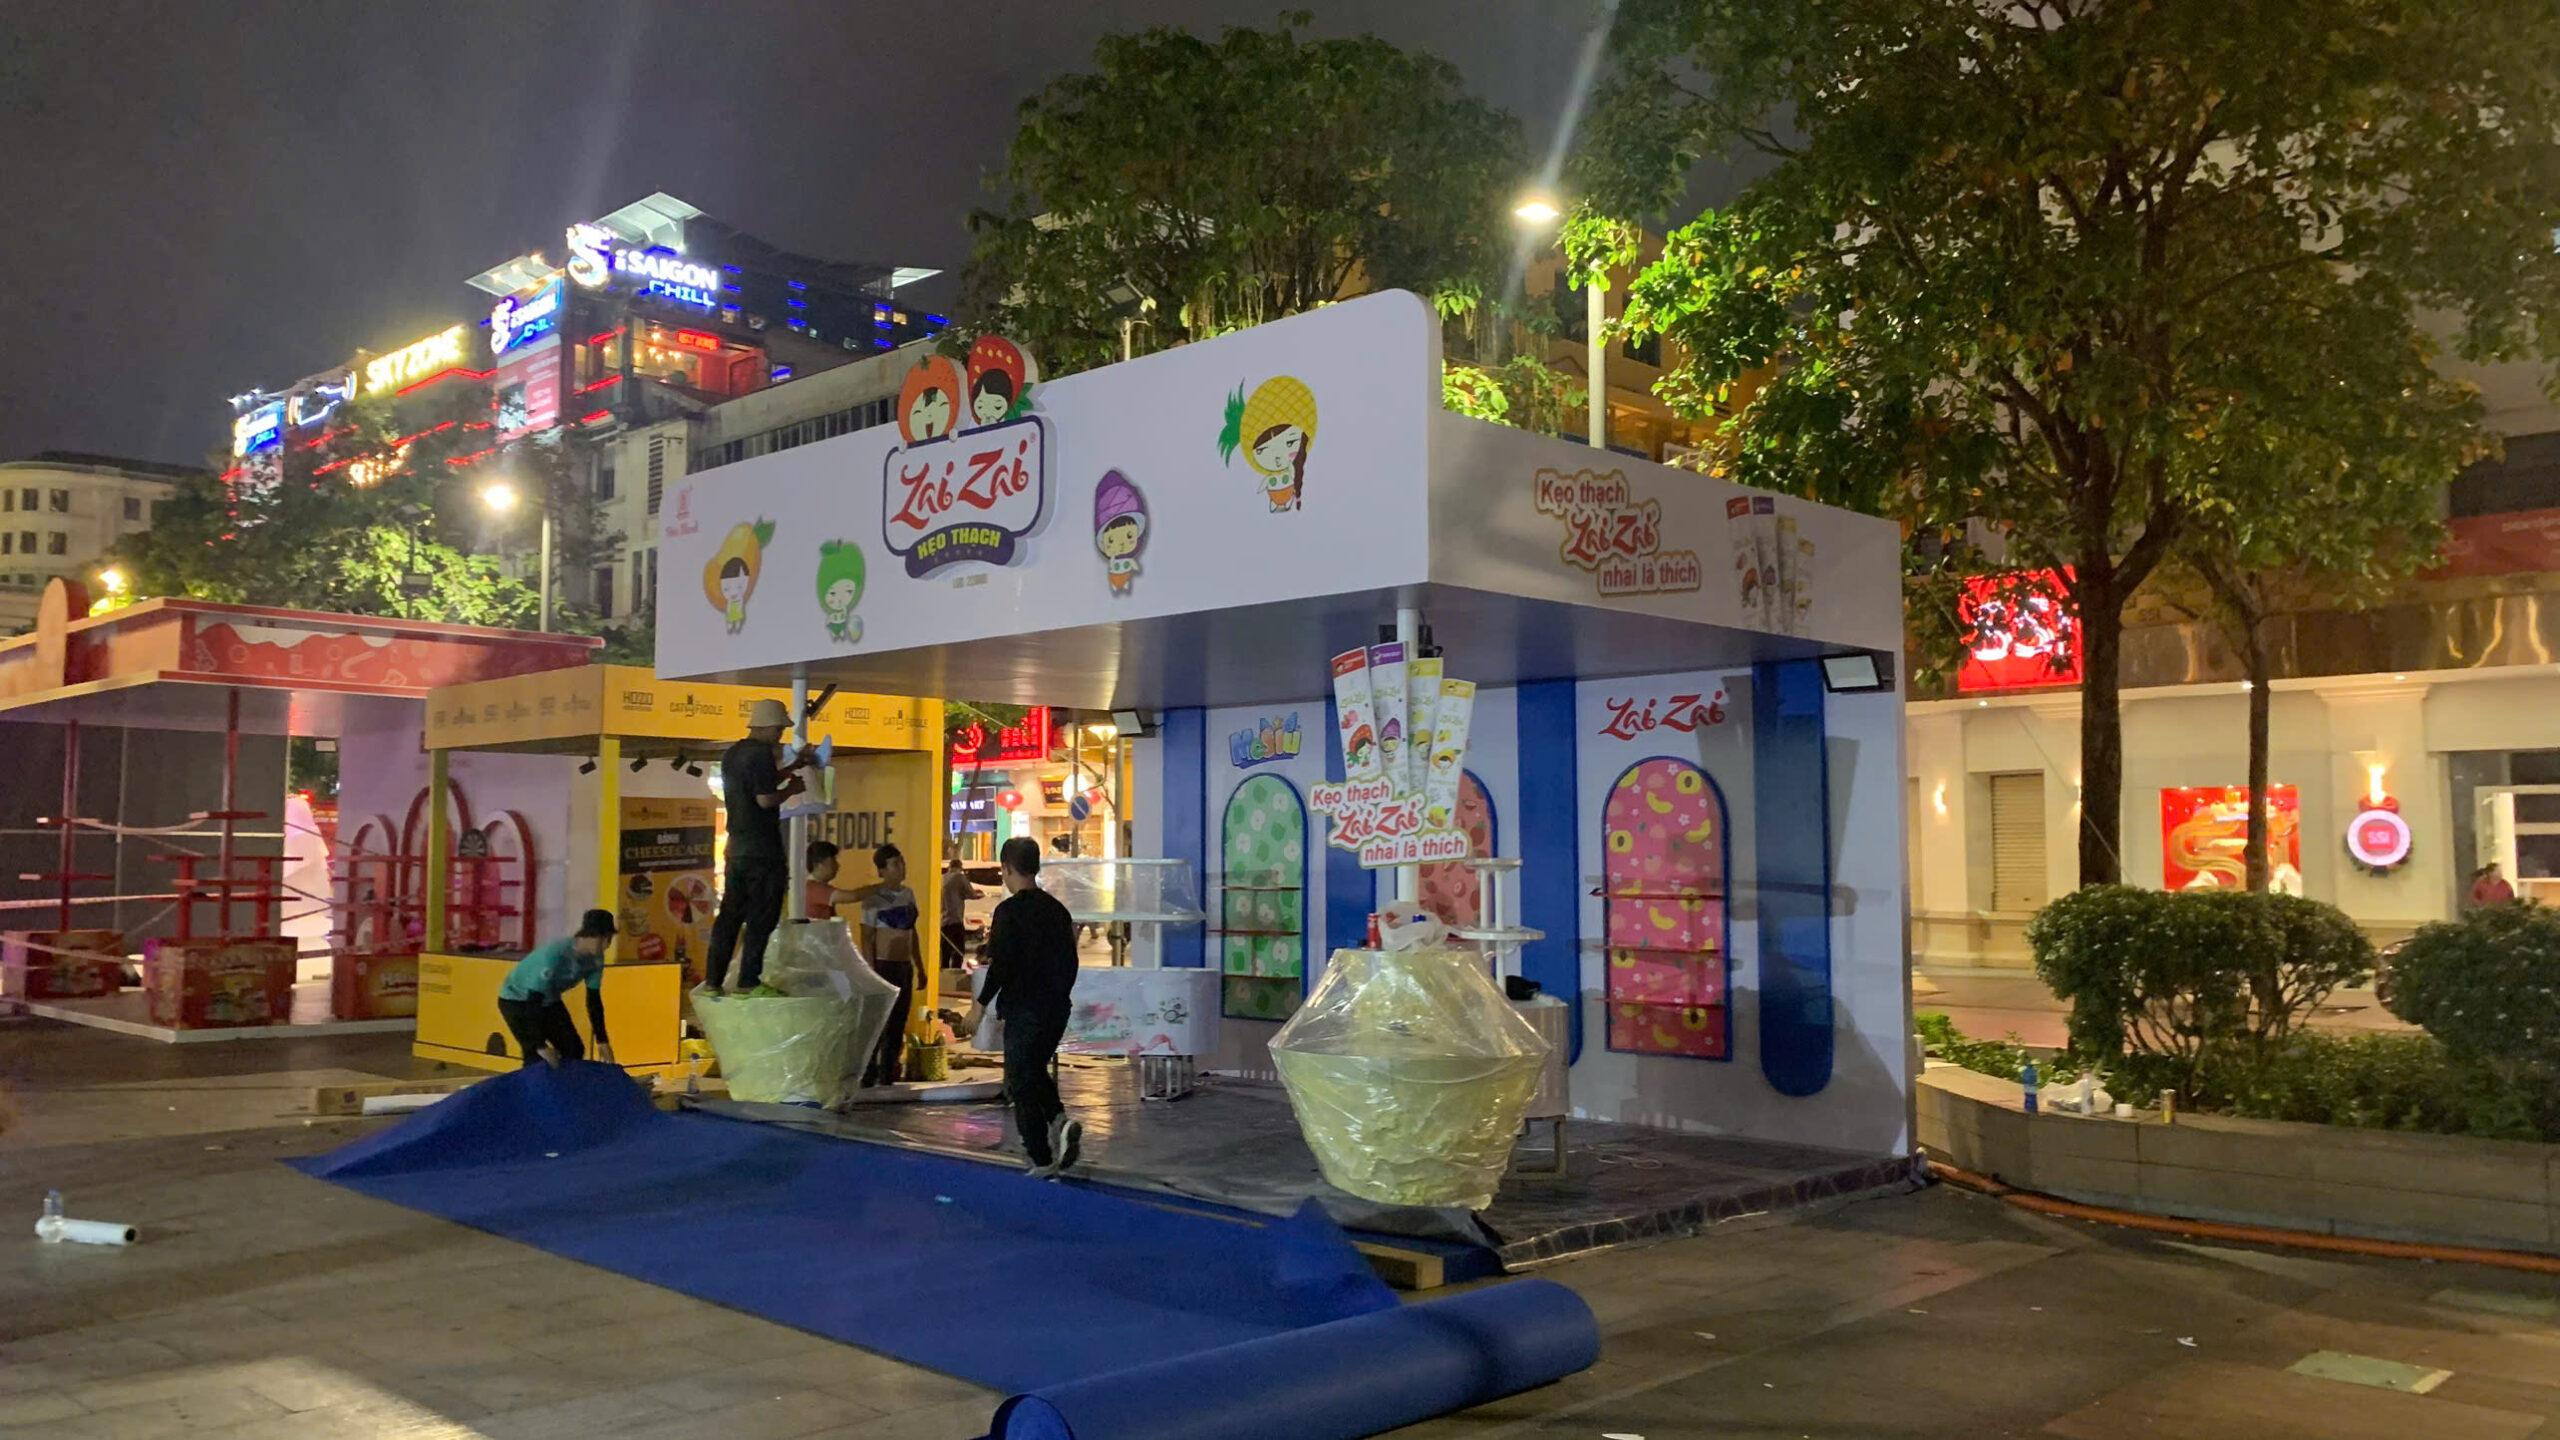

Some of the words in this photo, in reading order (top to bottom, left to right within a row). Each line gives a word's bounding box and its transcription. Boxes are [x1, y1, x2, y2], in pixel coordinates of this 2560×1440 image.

[649, 280, 716, 307] CHILL
[890, 461, 954, 530] Zai
[957, 440, 1029, 510] Zai
[1541, 480, 1574, 509] Kẹo
[1580, 480, 1624, 508] thạch
[951, 527, 1001, 548] THẠCH
[1567, 512, 1610, 563] Zai
[1613, 511, 1656, 555] Zai
[1603, 562, 1637, 587] nhai
[1642, 562, 1655, 585] là
[1659, 560, 1697, 585] thích
[1597, 697, 1656, 741] Zai
[1661, 690, 1725, 732] Zai
[1313, 788, 1342, 808] Kẹo
[1347, 782, 1390, 804] thạch
[1334, 809, 1373, 844] Zai
[1375, 801, 1419, 836] Zai
[1365, 843, 1398, 861] nhai
[1404, 840, 1417, 858] là
[1423, 836, 1465, 856] thích
[2367, 830, 2390, 845] SSI
